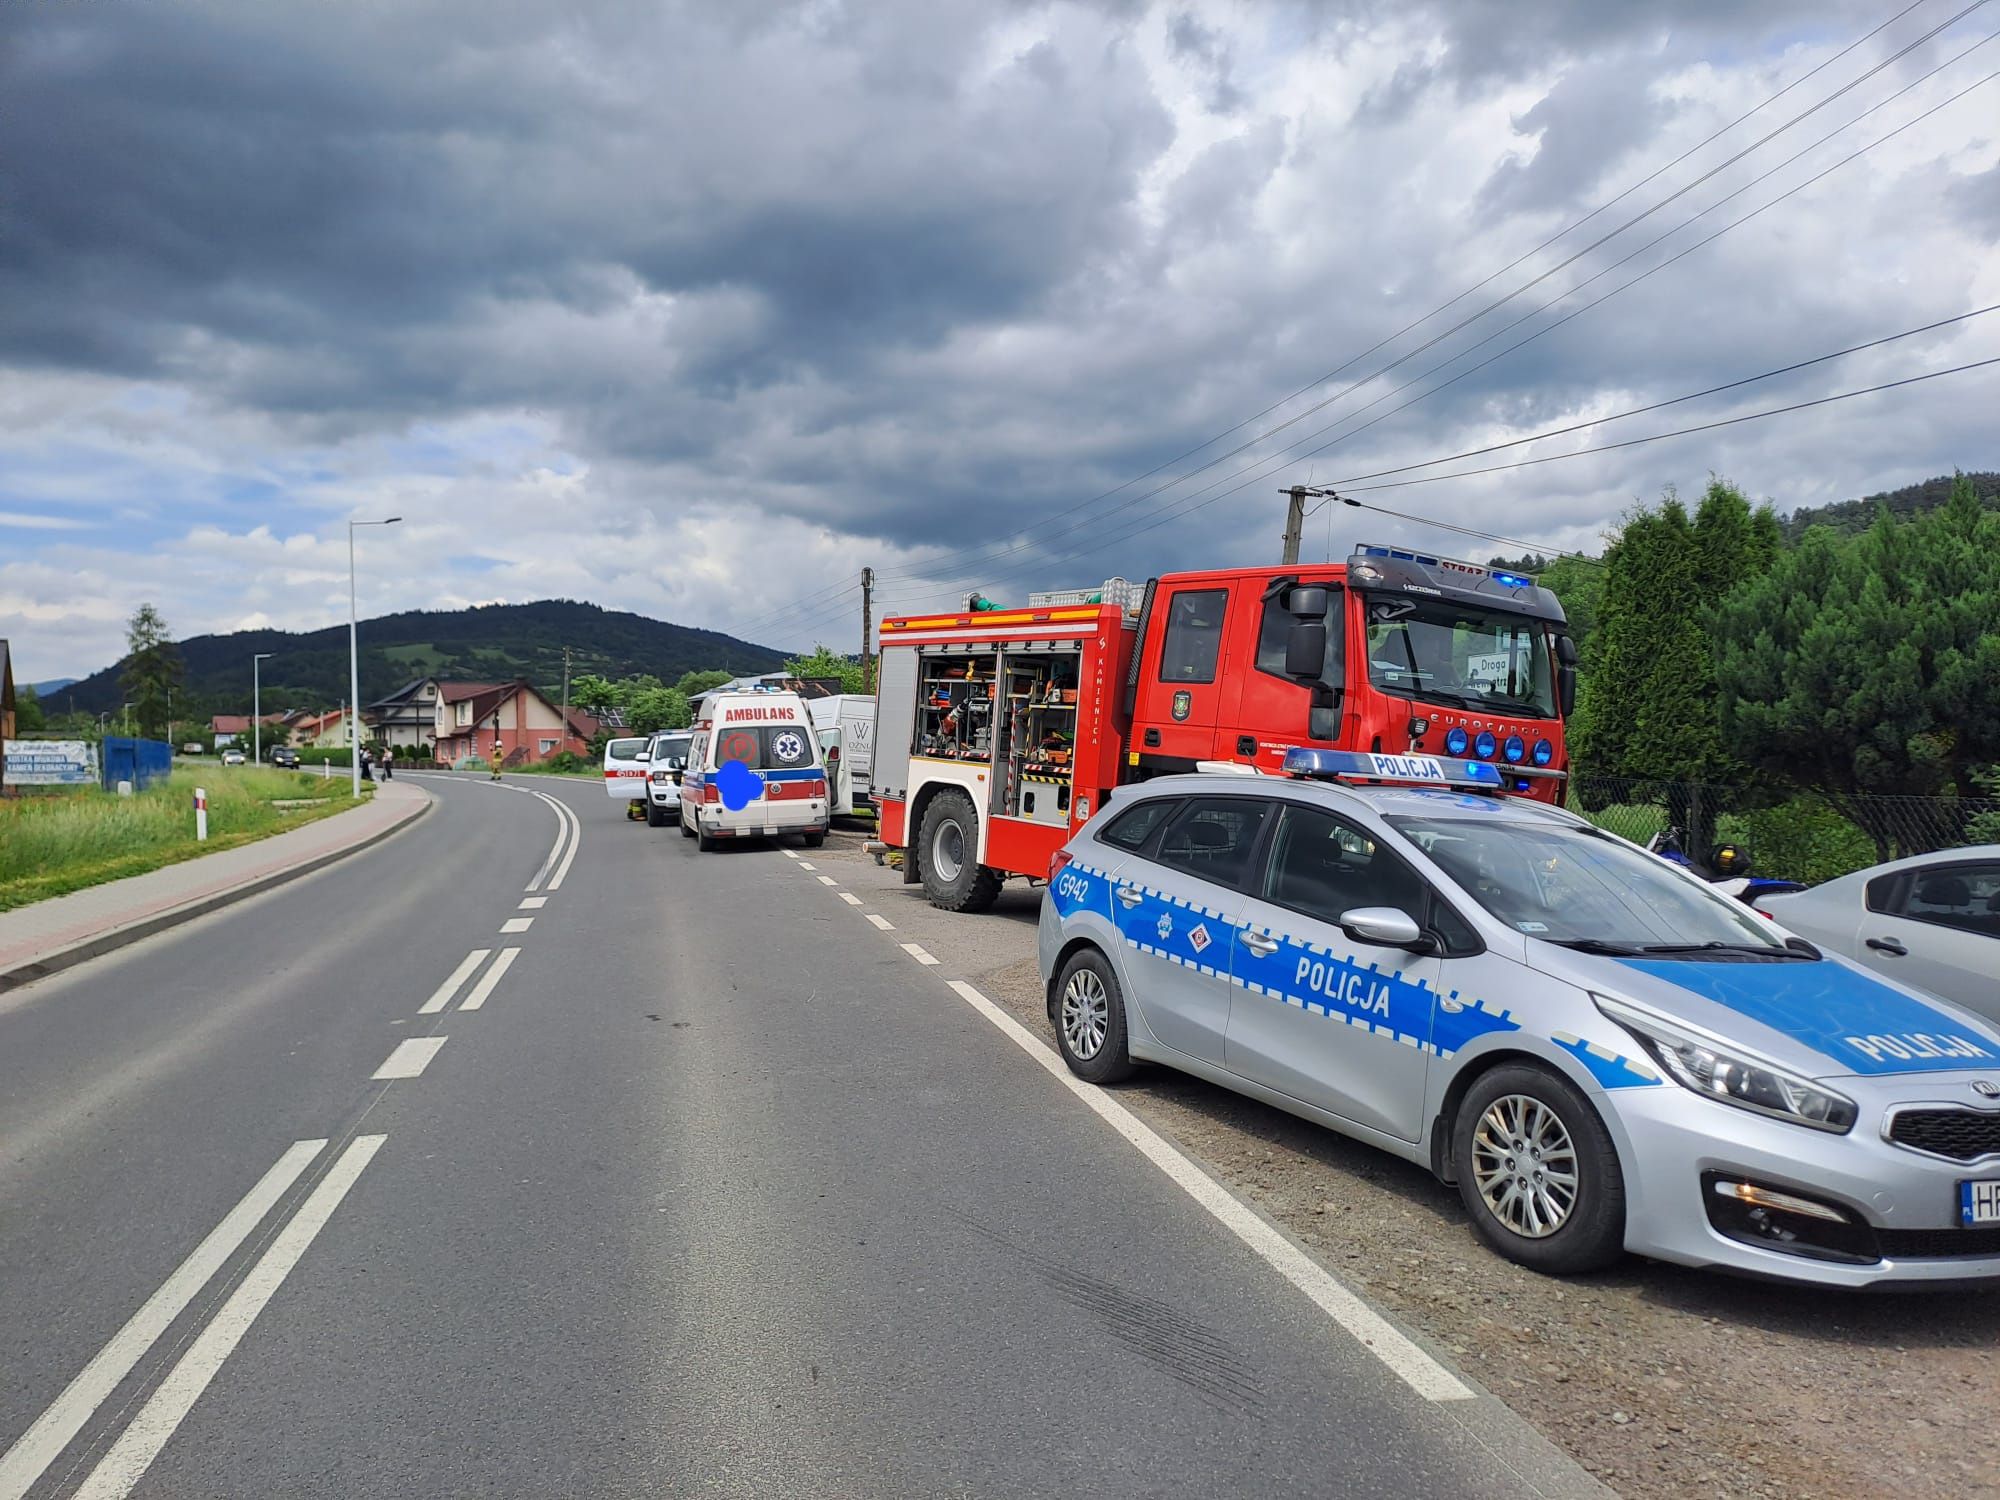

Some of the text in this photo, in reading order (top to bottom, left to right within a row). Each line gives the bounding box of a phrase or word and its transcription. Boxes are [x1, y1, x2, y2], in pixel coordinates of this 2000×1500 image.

[1481, 658, 1506, 672] Droga
[725, 707, 795, 722] AMBULANS
[1092, 658, 1104, 745] KAMIENICA
[1430, 713, 1540, 736] EUROCARGO
[1375, 756, 1441, 778] POLICJA
[1059, 873, 1089, 903] G942
[1295, 956, 1390, 1019] POLICJA
[1843, 1033, 1996, 1062] POLICJA
